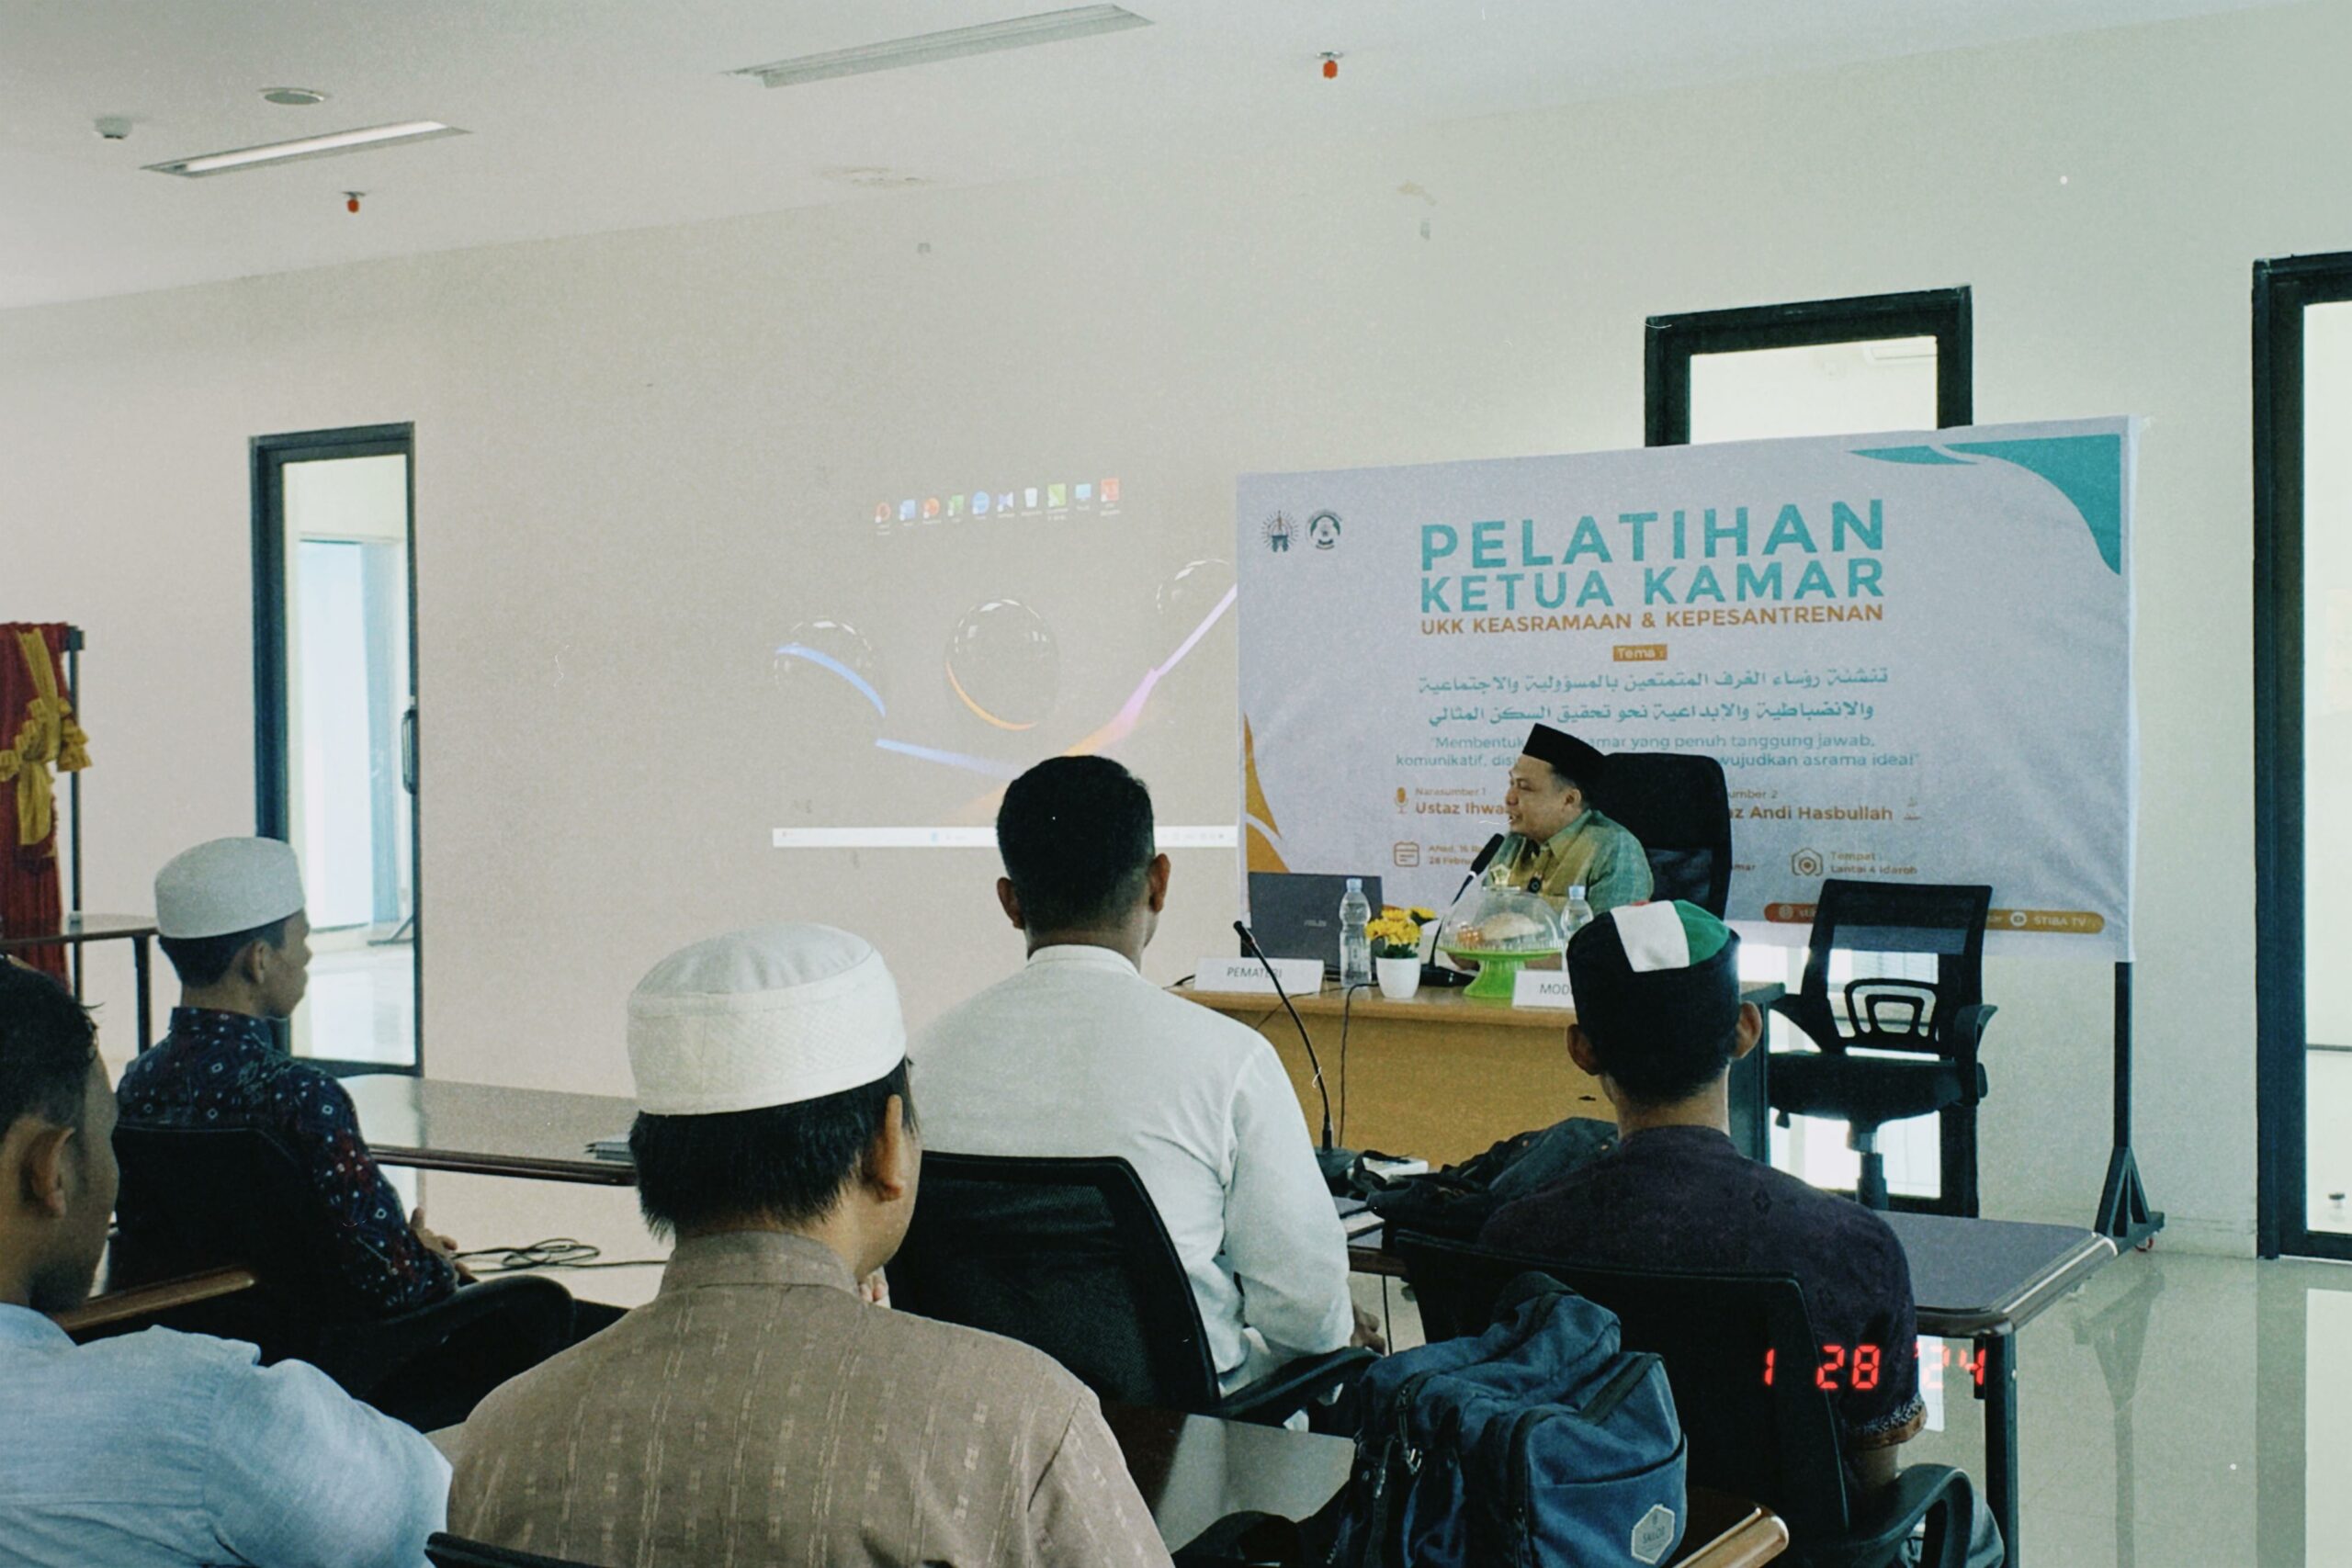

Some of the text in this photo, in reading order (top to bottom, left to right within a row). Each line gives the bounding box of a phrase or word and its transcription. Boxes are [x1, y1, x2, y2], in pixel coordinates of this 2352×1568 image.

[1421, 500, 1883, 570] PELATIHAN
[1421, 558, 1883, 614] KETUA KAMAR
[1421, 604, 1883, 635] UKK KEASRAMAAN & KEPESANTRENAN
[1617, 647, 1656, 660] Tema
[1632, 738, 1670, 749] yang
[1675, 734, 1726, 749] penuh
[1731, 735, 1815, 750] tanggung
[1803, 755, 1867, 766] asrama
[1416, 802, 1461, 815] Ustaz
[1749, 805, 1792, 819] Andi
[1798, 806, 1894, 821] Hasbullah
